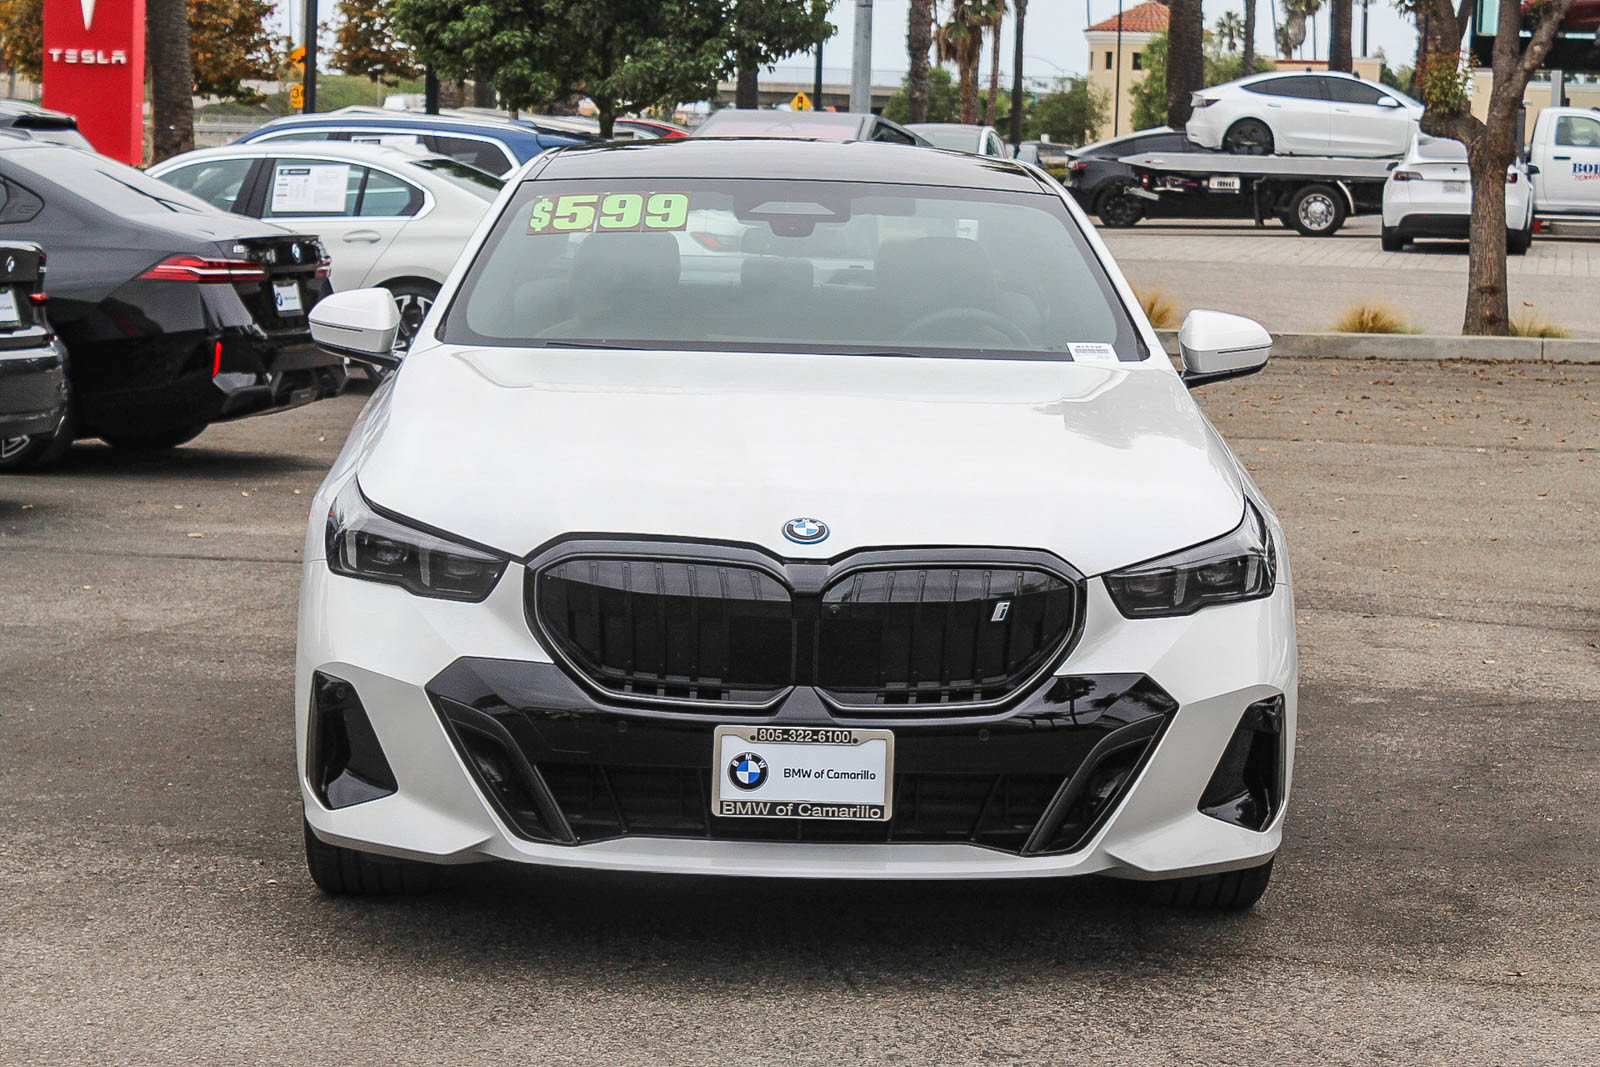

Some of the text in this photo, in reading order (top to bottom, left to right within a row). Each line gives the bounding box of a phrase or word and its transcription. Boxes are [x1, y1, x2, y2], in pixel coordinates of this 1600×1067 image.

[48, 48, 128, 65] TESLA
[529, 193, 689, 232] $599
[758, 729, 850, 744] 805-322-6100
[783, 768, 876, 780] BMW of Camarillo
[722, 802, 881, 819] BMW of Camarillo
